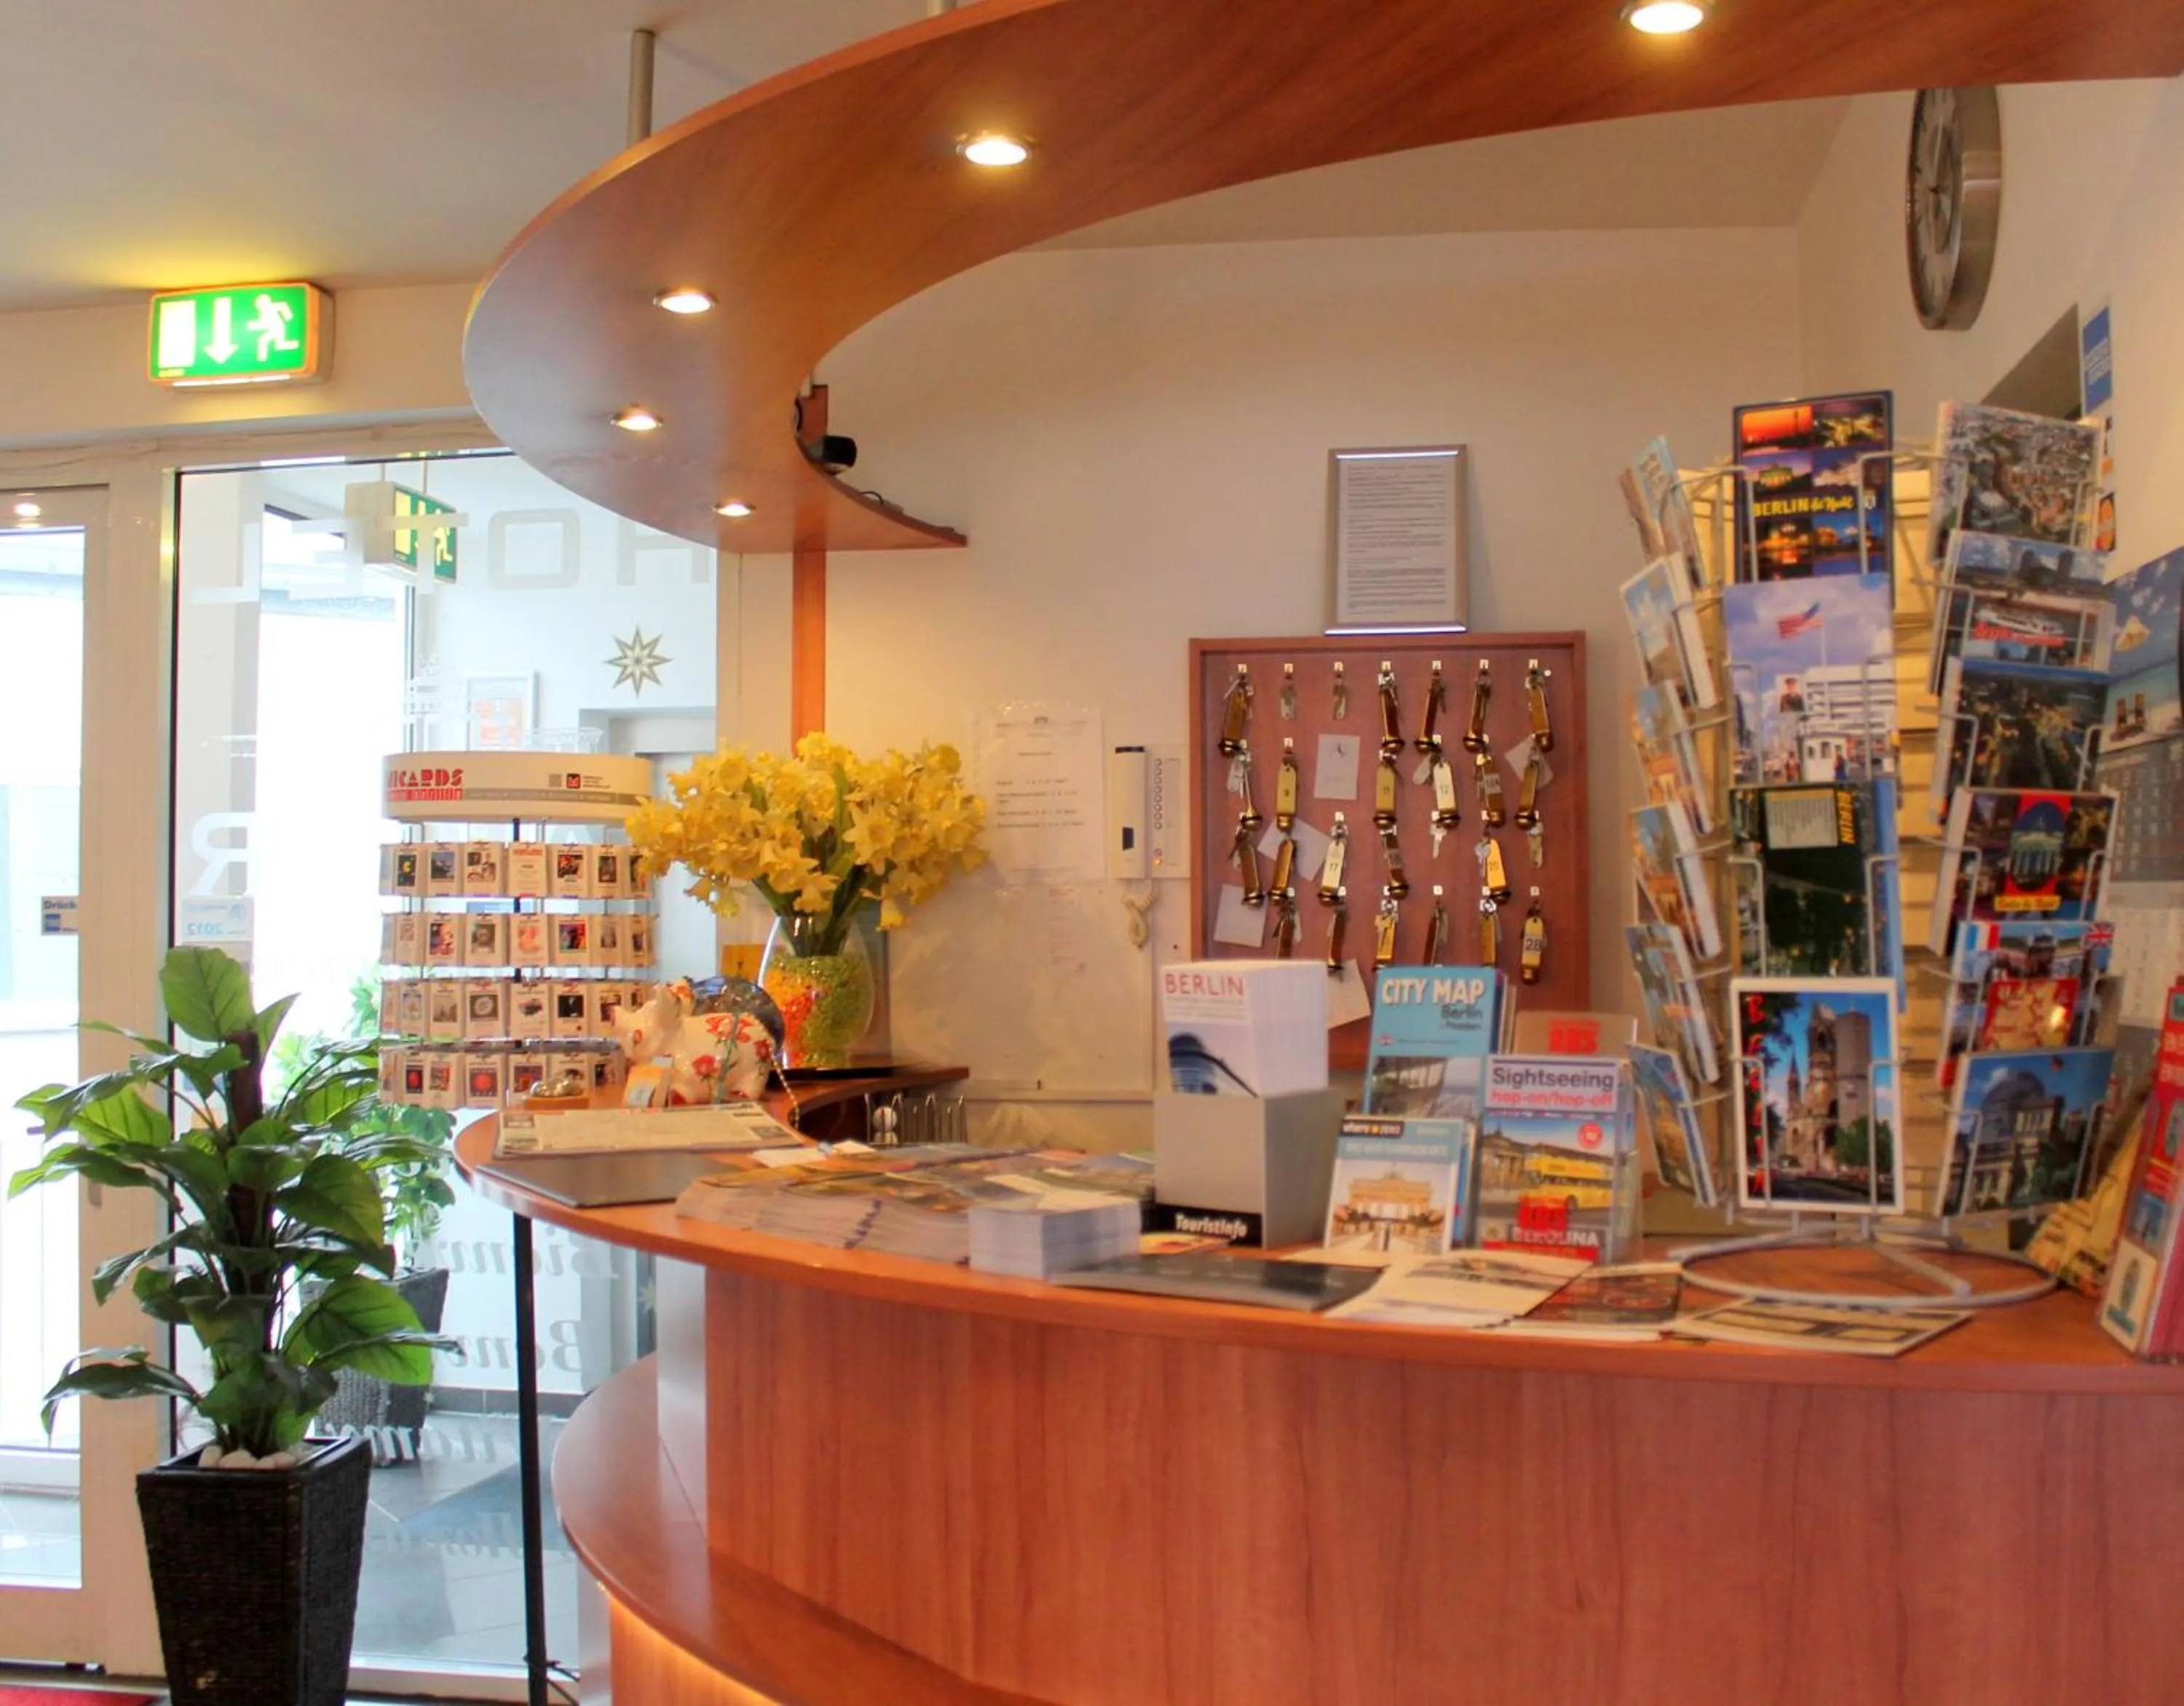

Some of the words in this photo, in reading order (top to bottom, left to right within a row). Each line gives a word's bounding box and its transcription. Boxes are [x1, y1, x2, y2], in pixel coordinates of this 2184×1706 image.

[1753, 498, 1808, 517] BERLIN
[1837, 791, 1856, 844] BERLIN
[1165, 973, 1244, 996] BERLIN
[1382, 977, 1428, 1005] CITY
[1432, 977, 1486, 1006] MAP
[1492, 1067, 1615, 1092] Sightseeing
[1489, 1088, 1613, 1107] hop-on/hop-off
[1174, 1212, 1248, 1239] Touristinfo
